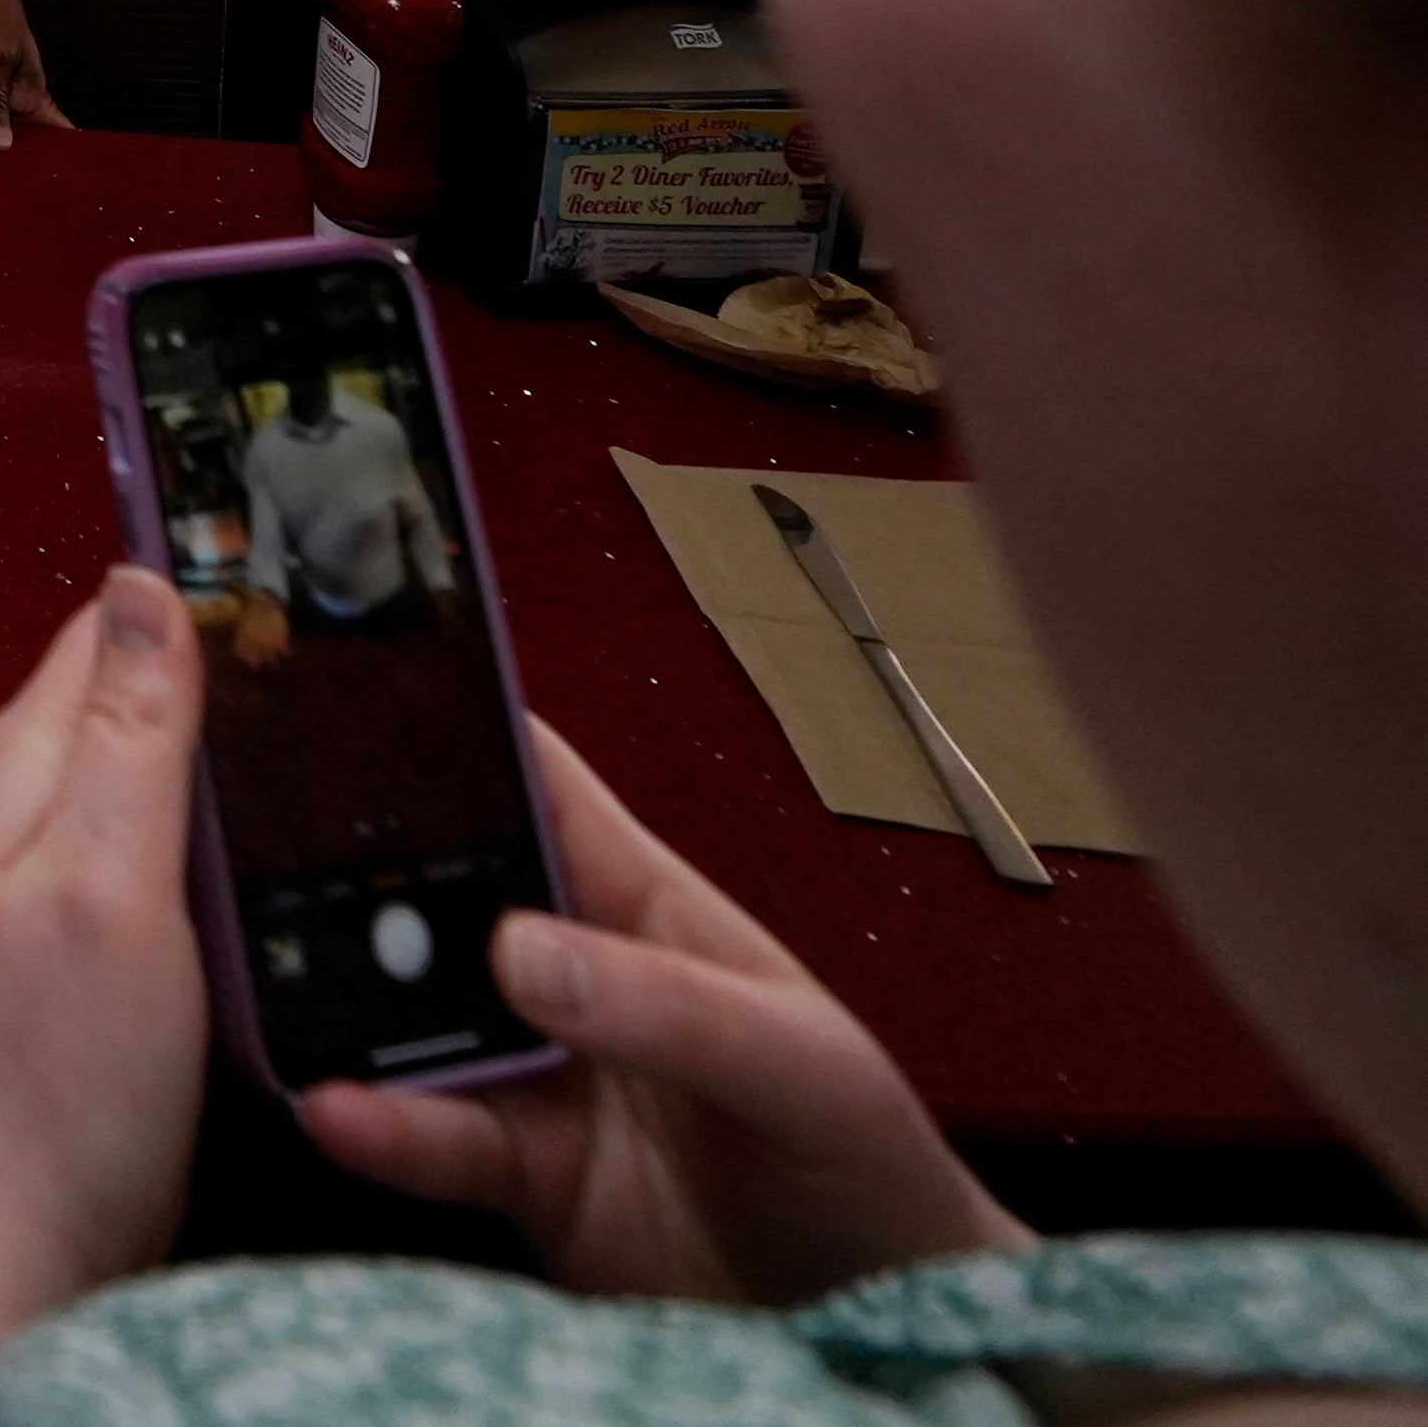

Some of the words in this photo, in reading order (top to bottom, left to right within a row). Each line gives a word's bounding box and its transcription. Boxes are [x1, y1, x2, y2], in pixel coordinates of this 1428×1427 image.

[326, 33, 355, 66] HEINZ
[674, 31, 717, 45] TORK
[652, 118, 689, 138] Red
[571, 165, 605, 191] Try
[610, 166, 623, 185] 2
[632, 166, 693, 187] Diner
[567, 193, 643, 215] Receive
[648, 195, 674, 215] $5
[681, 197, 765, 216] Voucher
